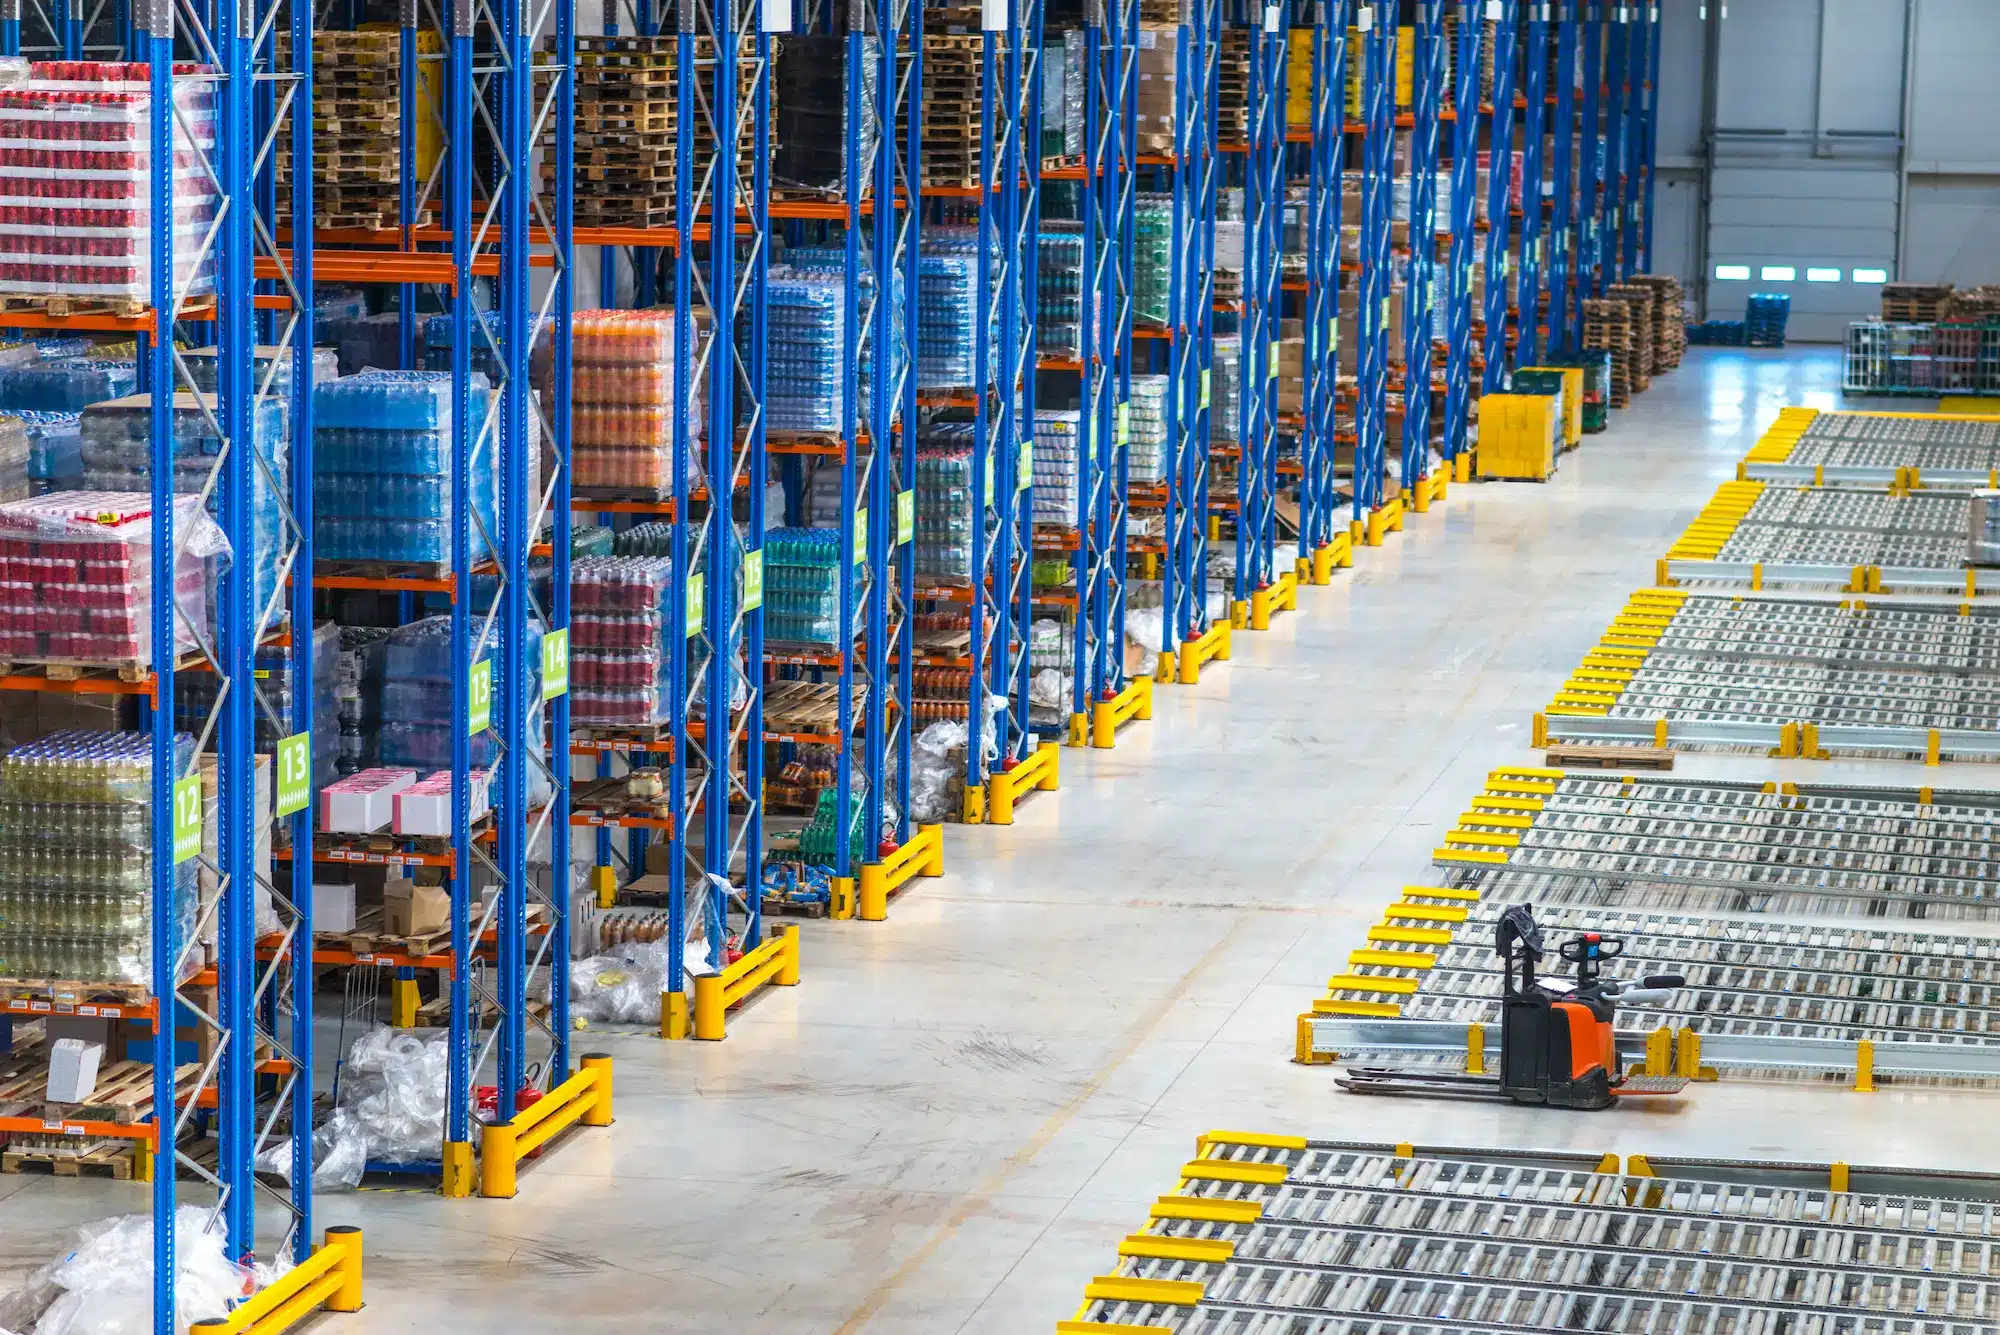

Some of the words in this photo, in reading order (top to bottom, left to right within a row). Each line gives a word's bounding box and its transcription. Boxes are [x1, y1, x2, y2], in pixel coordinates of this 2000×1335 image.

[901, 496, 913, 524] 16
[857, 515, 866, 543] 15
[748, 557, 761, 588] 15
[689, 581, 702, 613] 14
[548, 636, 566, 672] 14
[472, 669, 489, 705] 13
[283, 742, 307, 784] 13
[177, 785, 198, 829] 12
